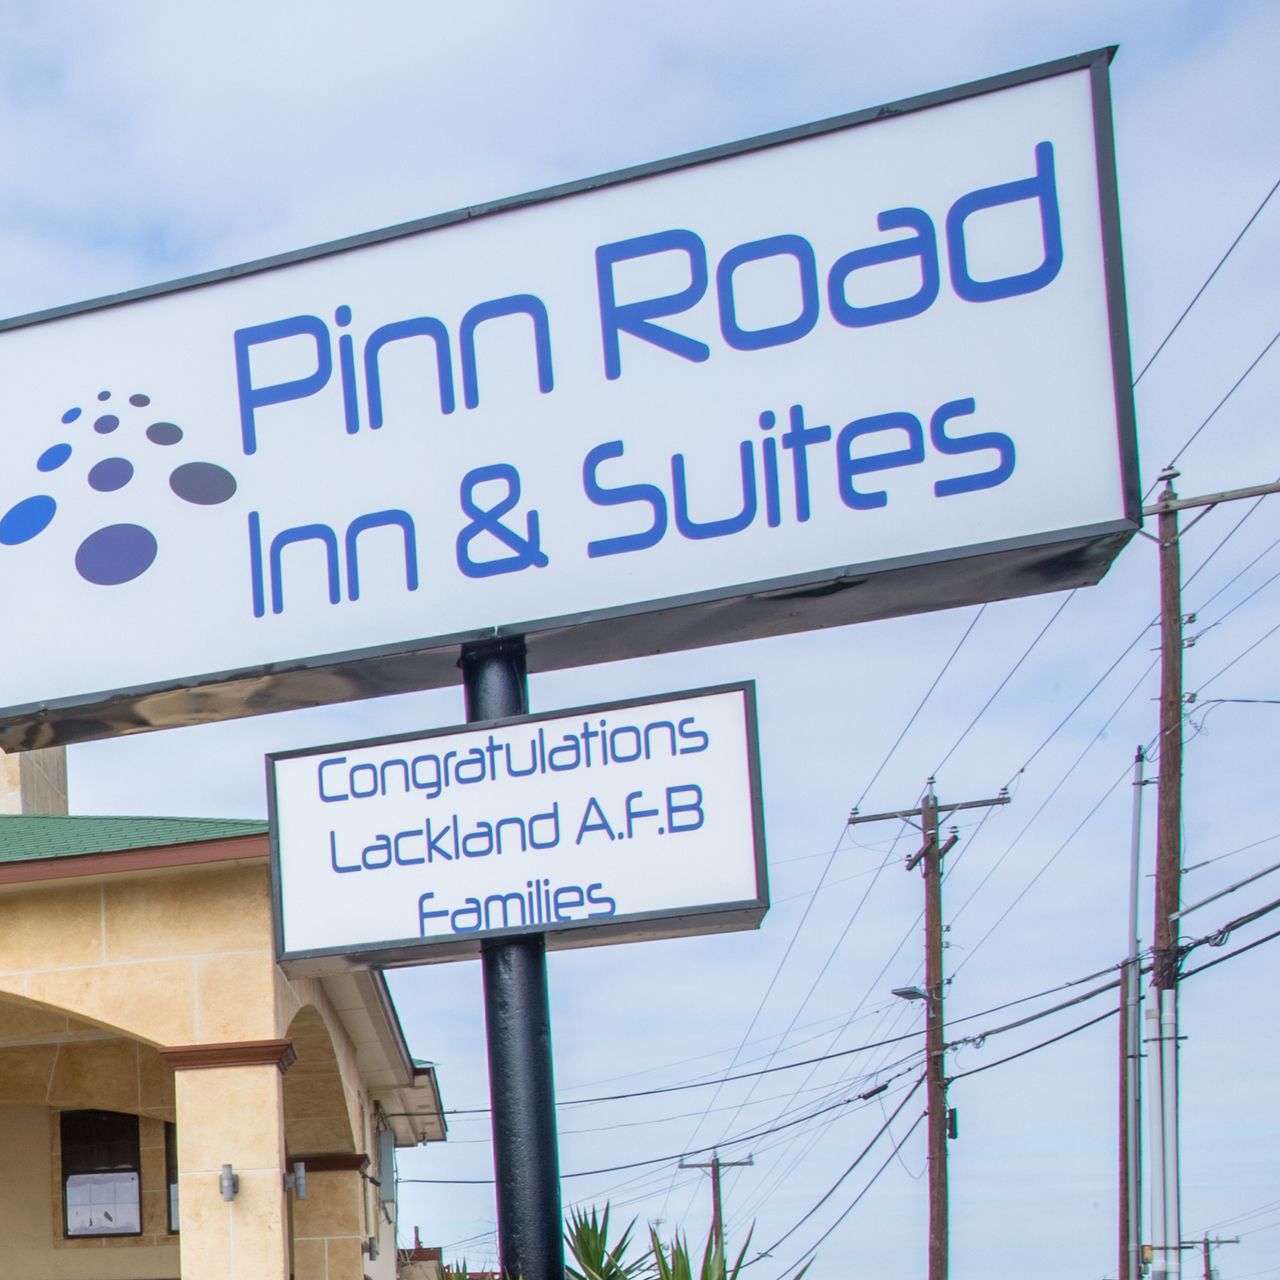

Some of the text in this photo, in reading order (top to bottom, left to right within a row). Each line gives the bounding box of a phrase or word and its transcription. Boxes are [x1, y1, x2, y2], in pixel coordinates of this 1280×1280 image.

[234, 140, 1065, 456] Pinn Road
[247, 396, 1017, 619] Inn & Suites
[317, 716, 710, 803] Congratulations
[330, 801, 560, 874] Lackland
[418, 879, 616, 938] Families
